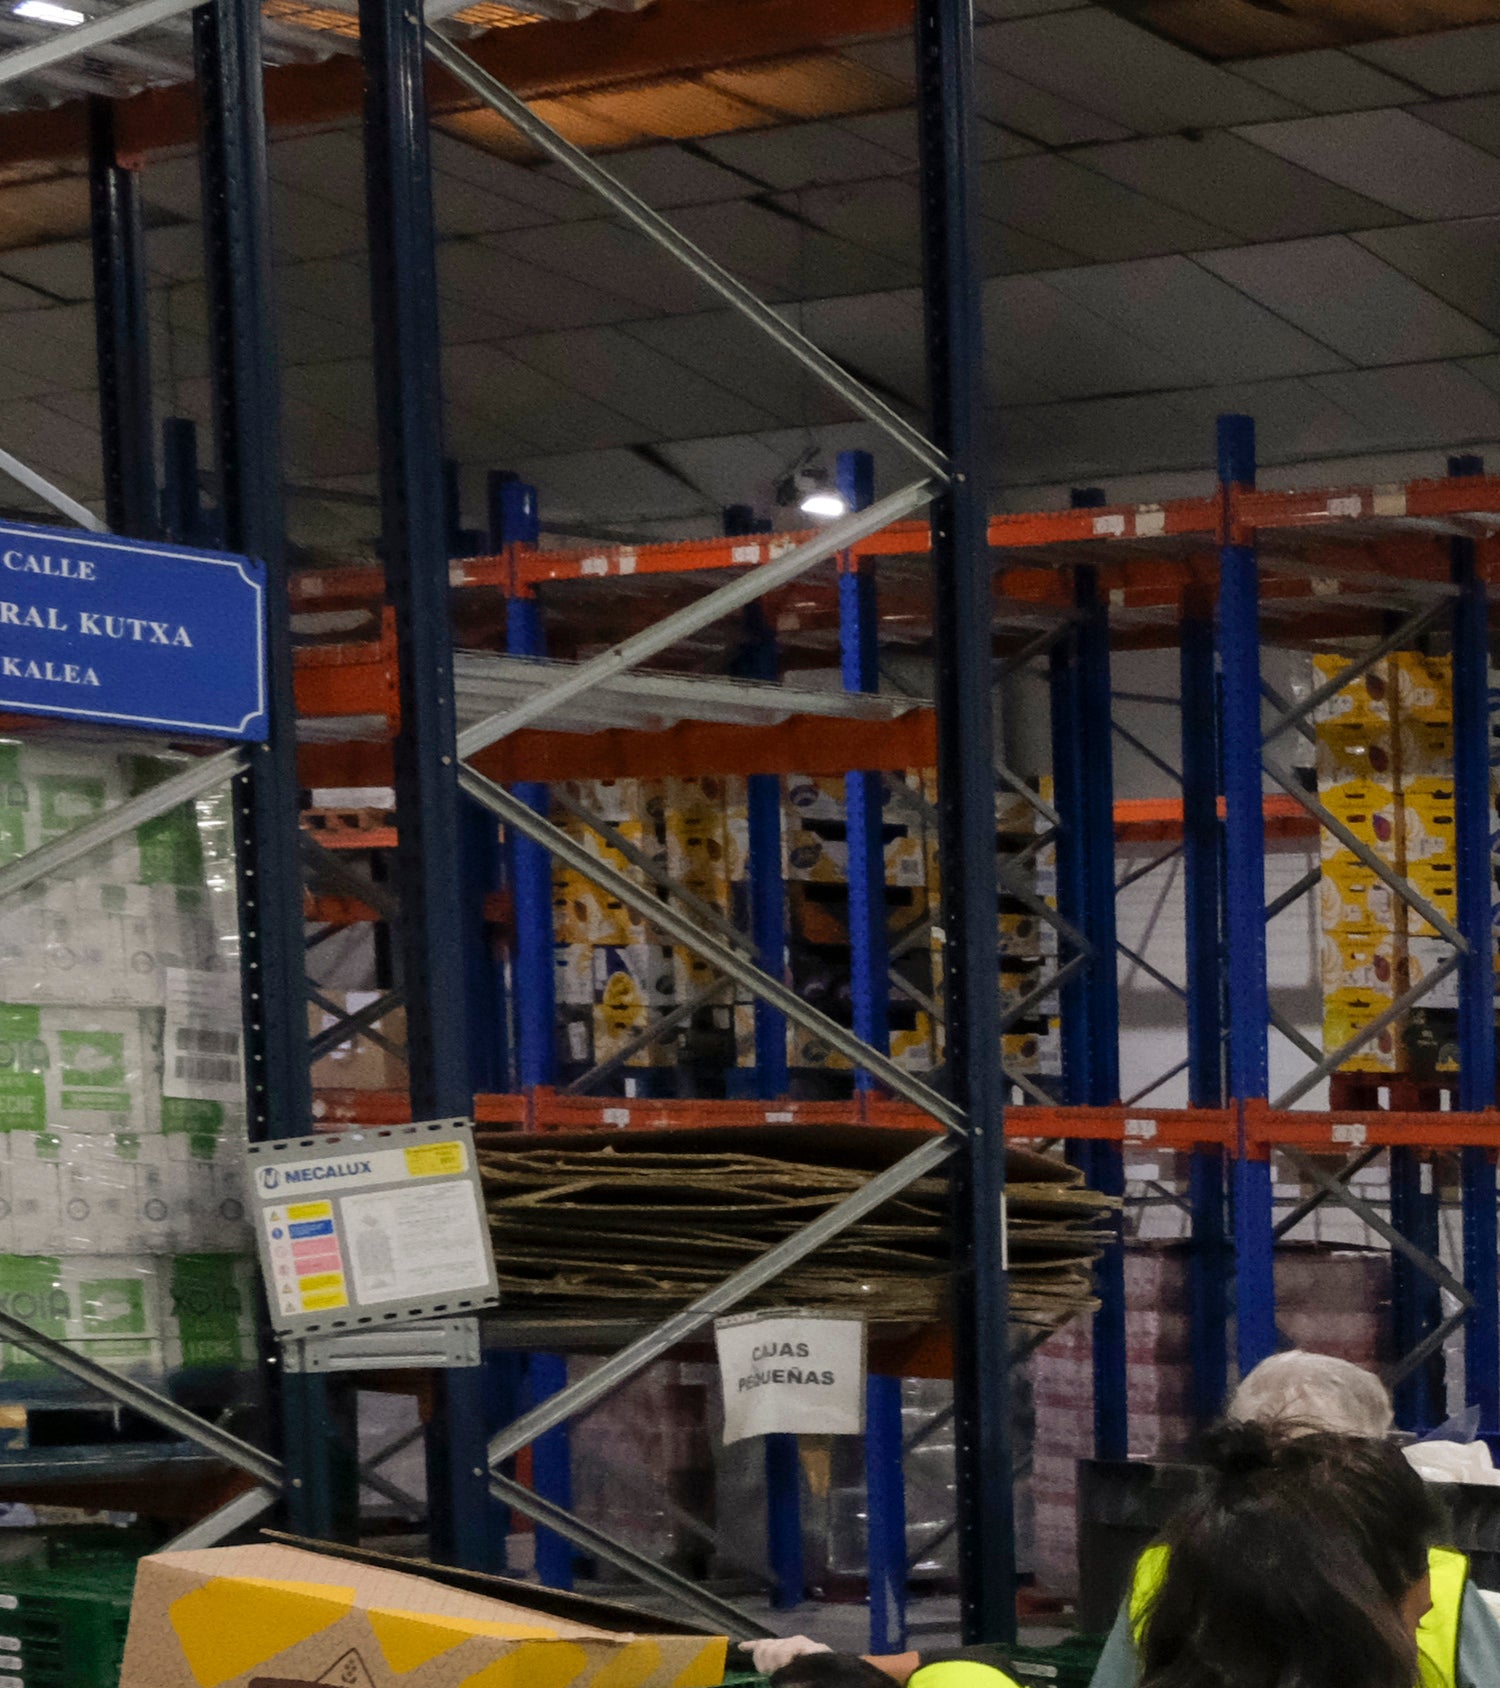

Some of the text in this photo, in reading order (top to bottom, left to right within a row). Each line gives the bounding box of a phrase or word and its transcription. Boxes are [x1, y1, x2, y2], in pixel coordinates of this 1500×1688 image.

[3, 551, 96, 580] CALLE
[79, 611, 193, 647] KUTXA
[2, 656, 100, 686] KALEA
[285, 1161, 372, 1184] MECALUX
